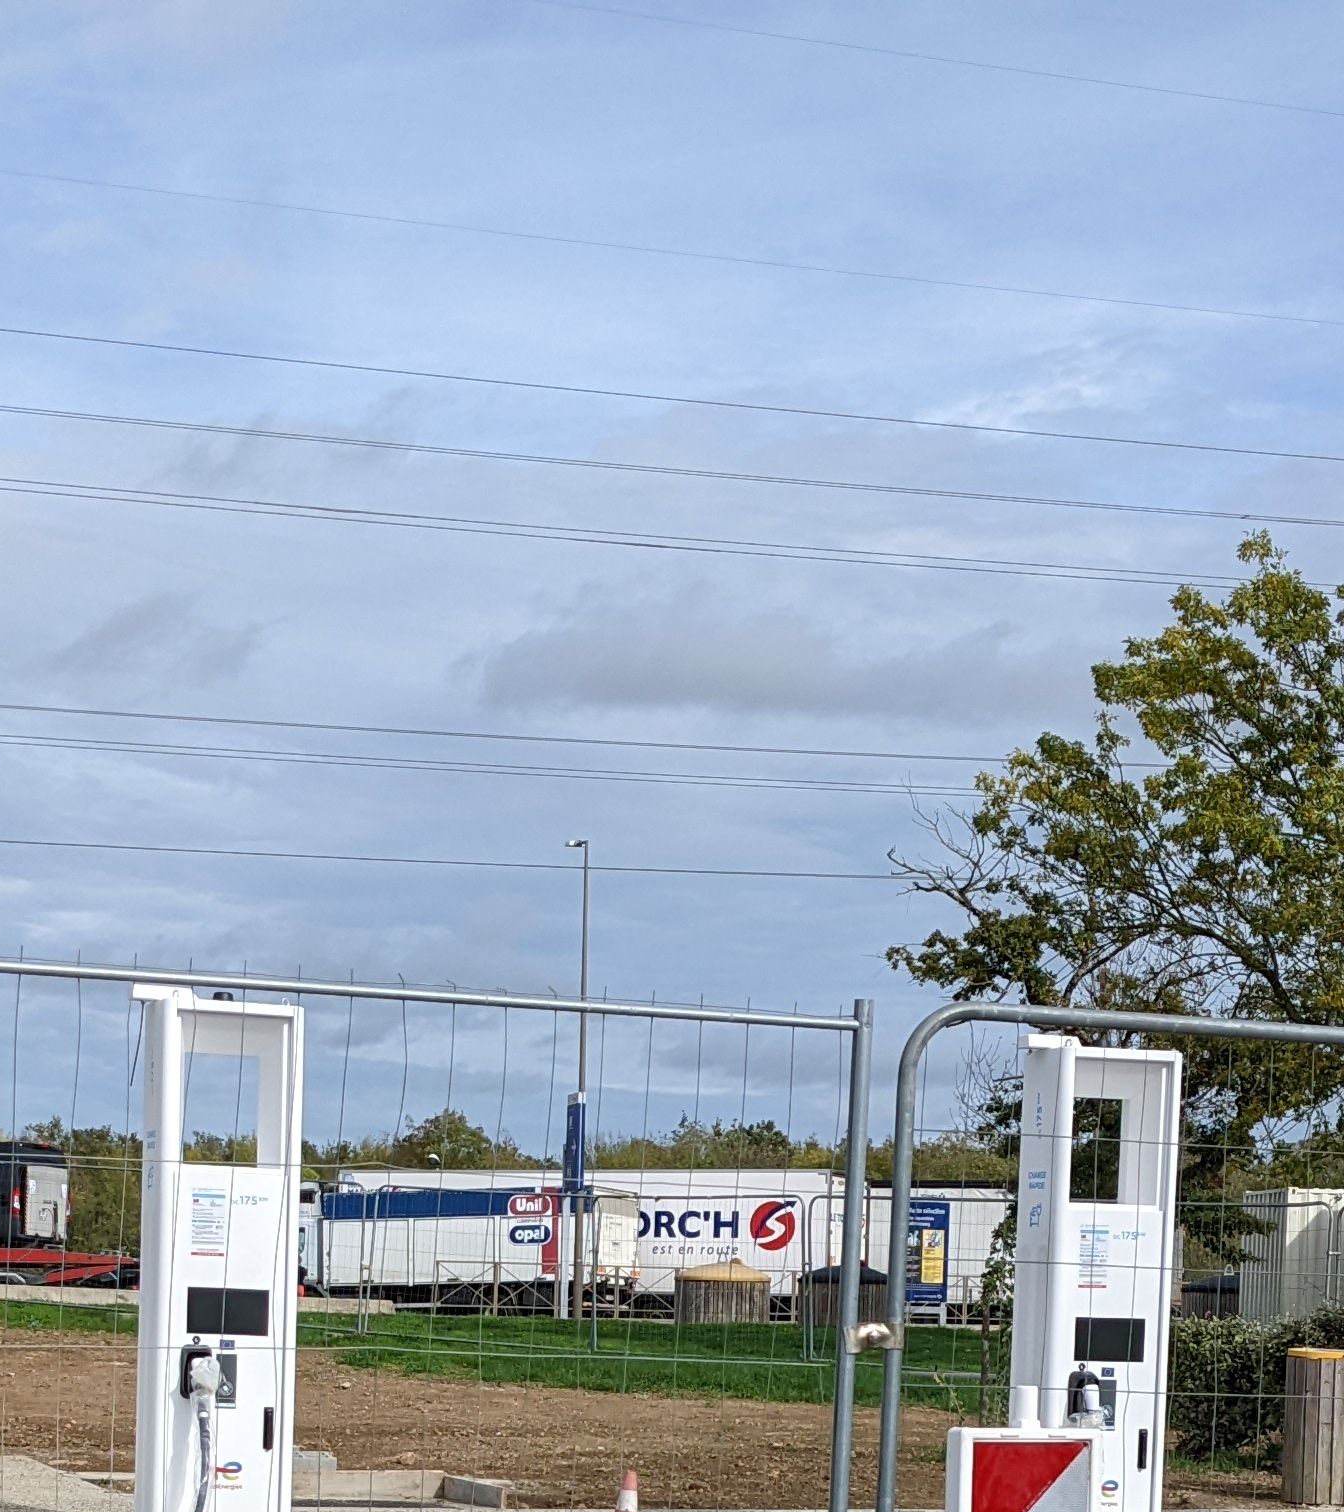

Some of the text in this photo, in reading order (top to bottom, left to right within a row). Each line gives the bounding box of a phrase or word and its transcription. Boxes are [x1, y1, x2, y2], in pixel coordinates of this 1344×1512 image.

[240, 1195, 258, 1206] 175
[516, 1197, 542, 1212] Unil
[515, 1225, 545, 1243] opal
[1121, 1231, 1137, 1241] 175
[652, 1244, 739, 1255] est en route
